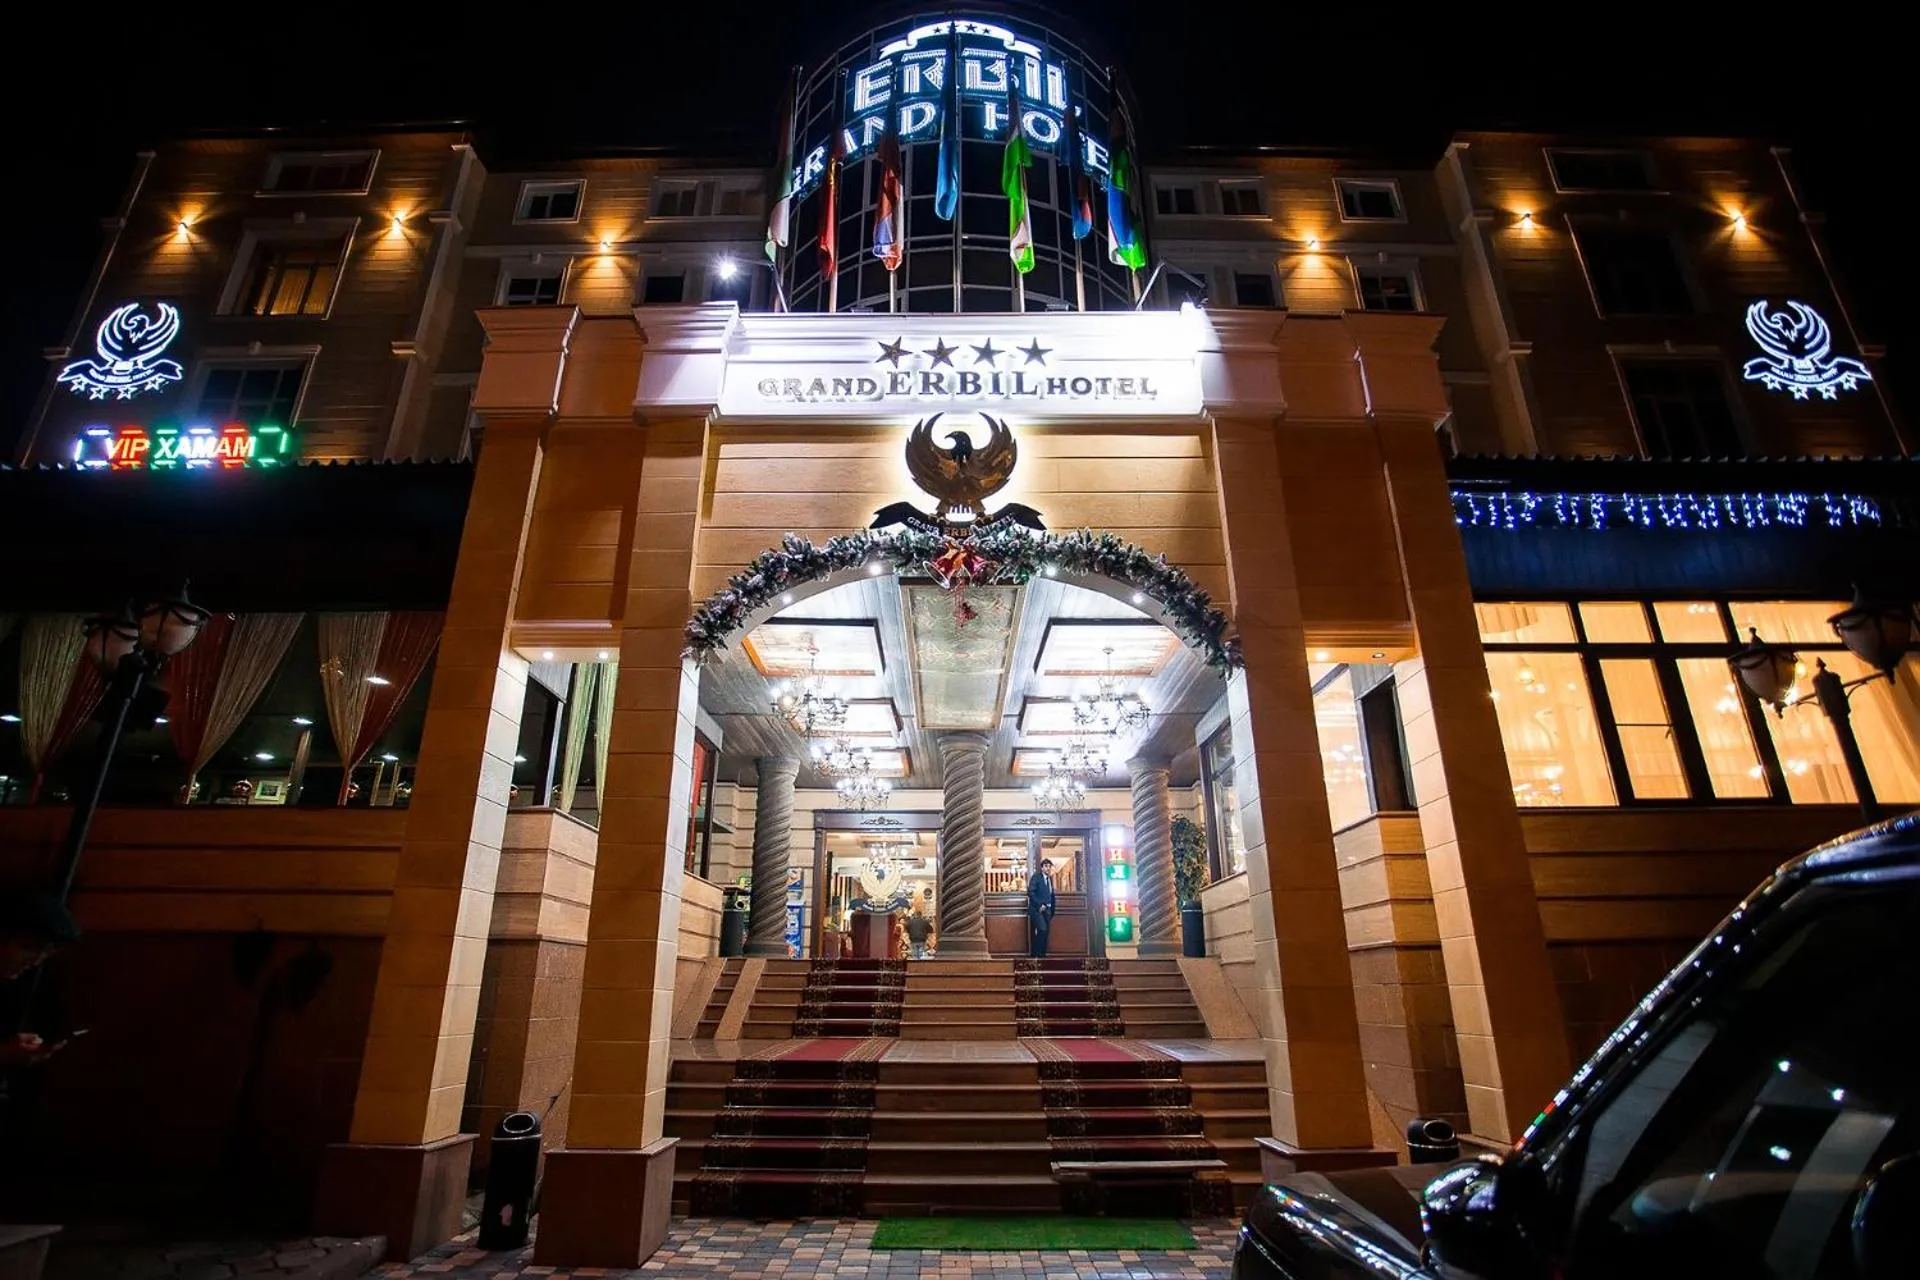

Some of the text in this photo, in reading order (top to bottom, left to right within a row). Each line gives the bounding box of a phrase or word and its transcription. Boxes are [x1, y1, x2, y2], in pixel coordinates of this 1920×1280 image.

[757, 371, 1157, 398] GRAND ERBIL HOTEL
[105, 437, 150, 459] VIP
[943, 525, 976, 538] ERBI
